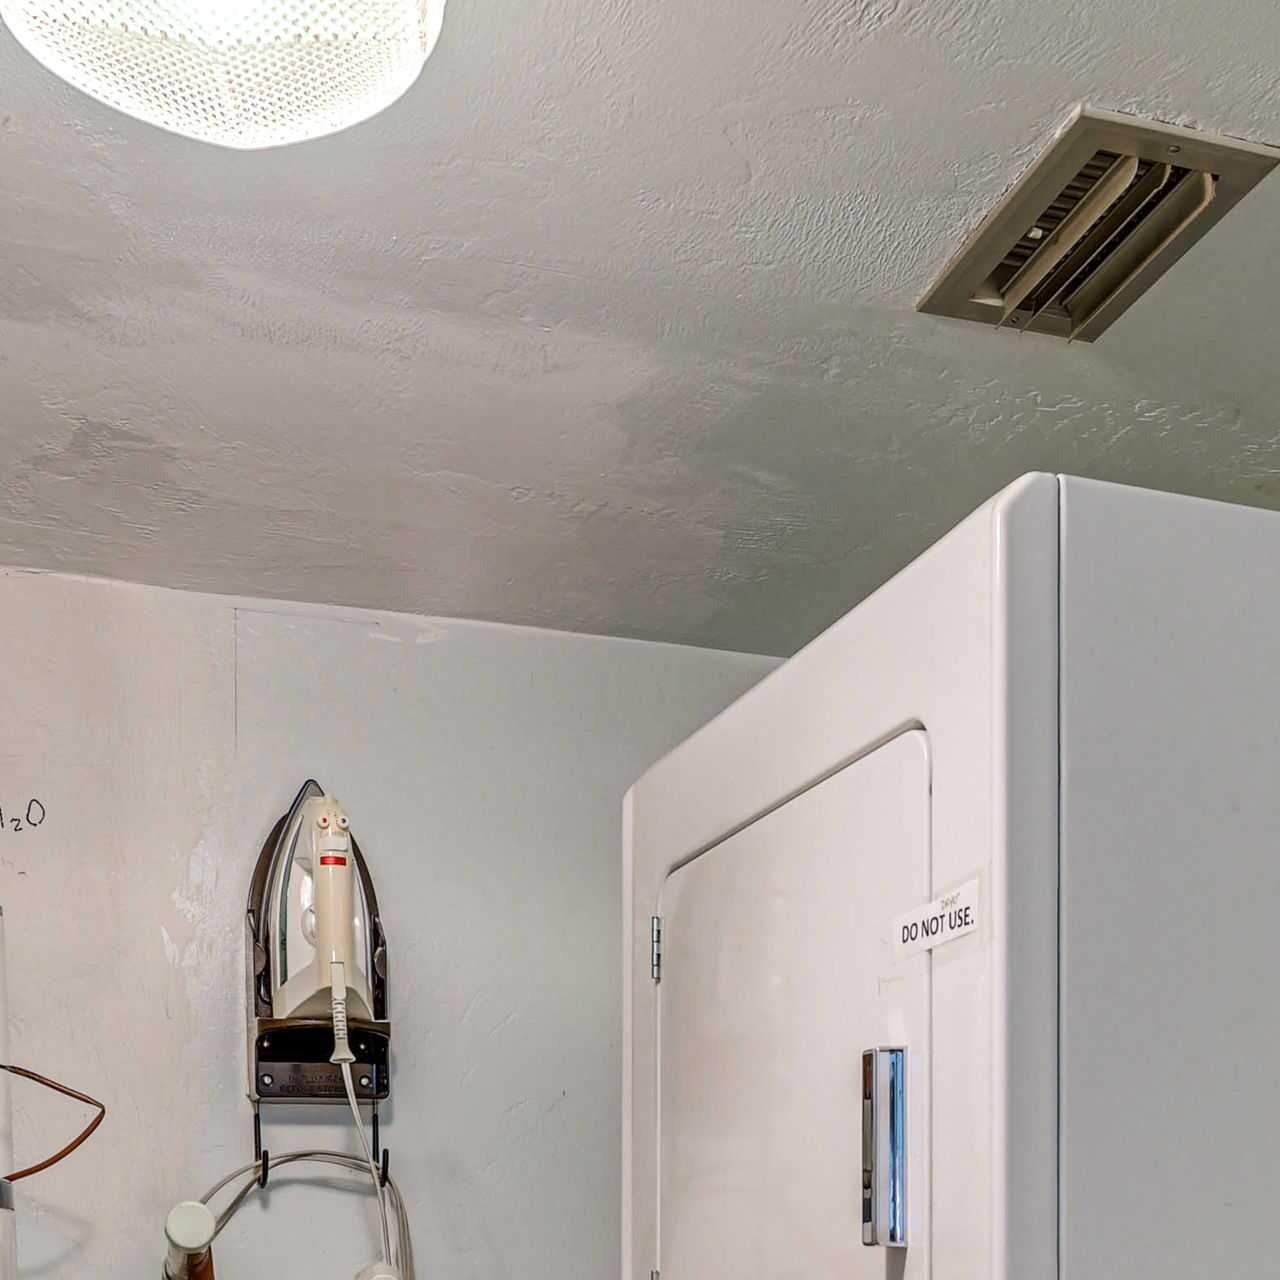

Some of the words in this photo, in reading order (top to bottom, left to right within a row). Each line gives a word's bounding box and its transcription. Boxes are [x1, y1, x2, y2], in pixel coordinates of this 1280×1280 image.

[902, 922, 918, 944] DO
[921, 914, 945, 938] NOT
[949, 906, 974, 930] USE.
